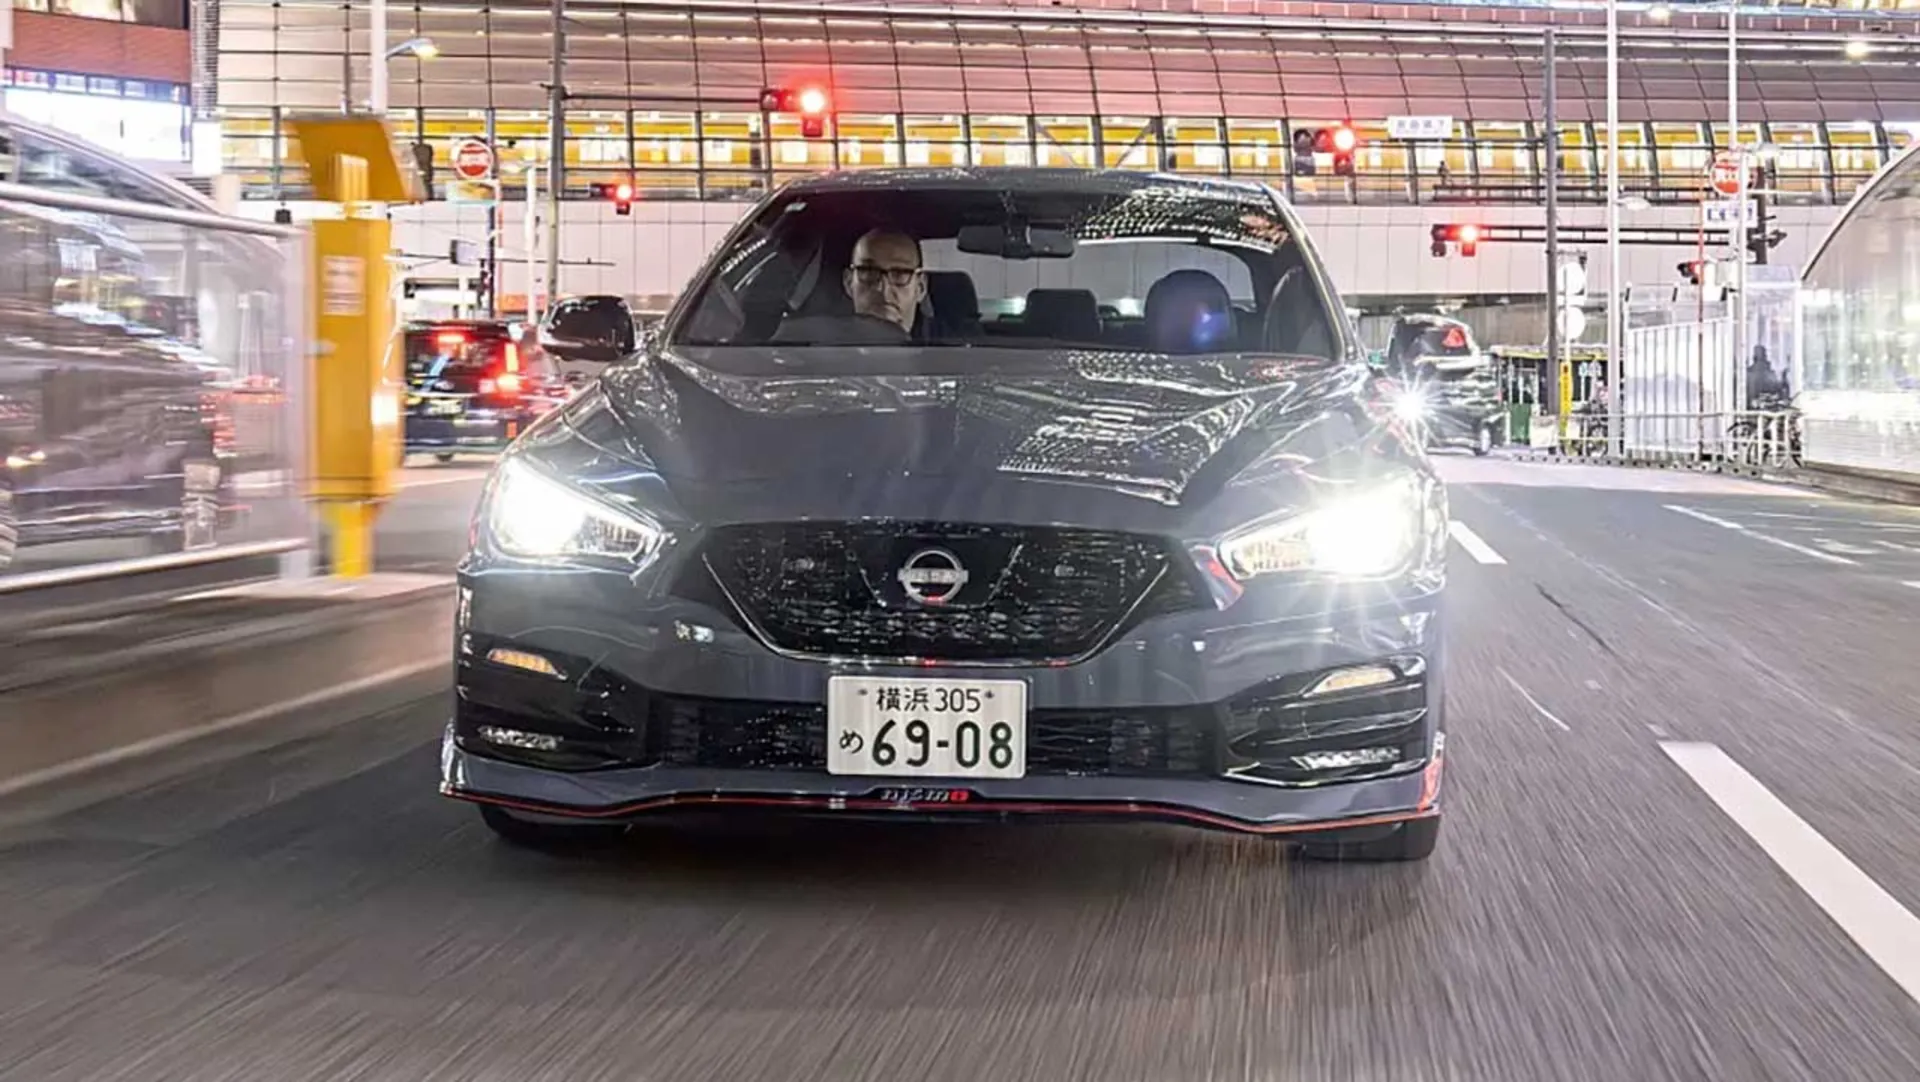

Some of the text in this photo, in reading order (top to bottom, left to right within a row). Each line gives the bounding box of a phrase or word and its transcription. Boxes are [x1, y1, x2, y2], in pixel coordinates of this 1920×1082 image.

[876, 686, 981, 713] 横浜 305
[839, 719, 1013, 769] め 69-08
